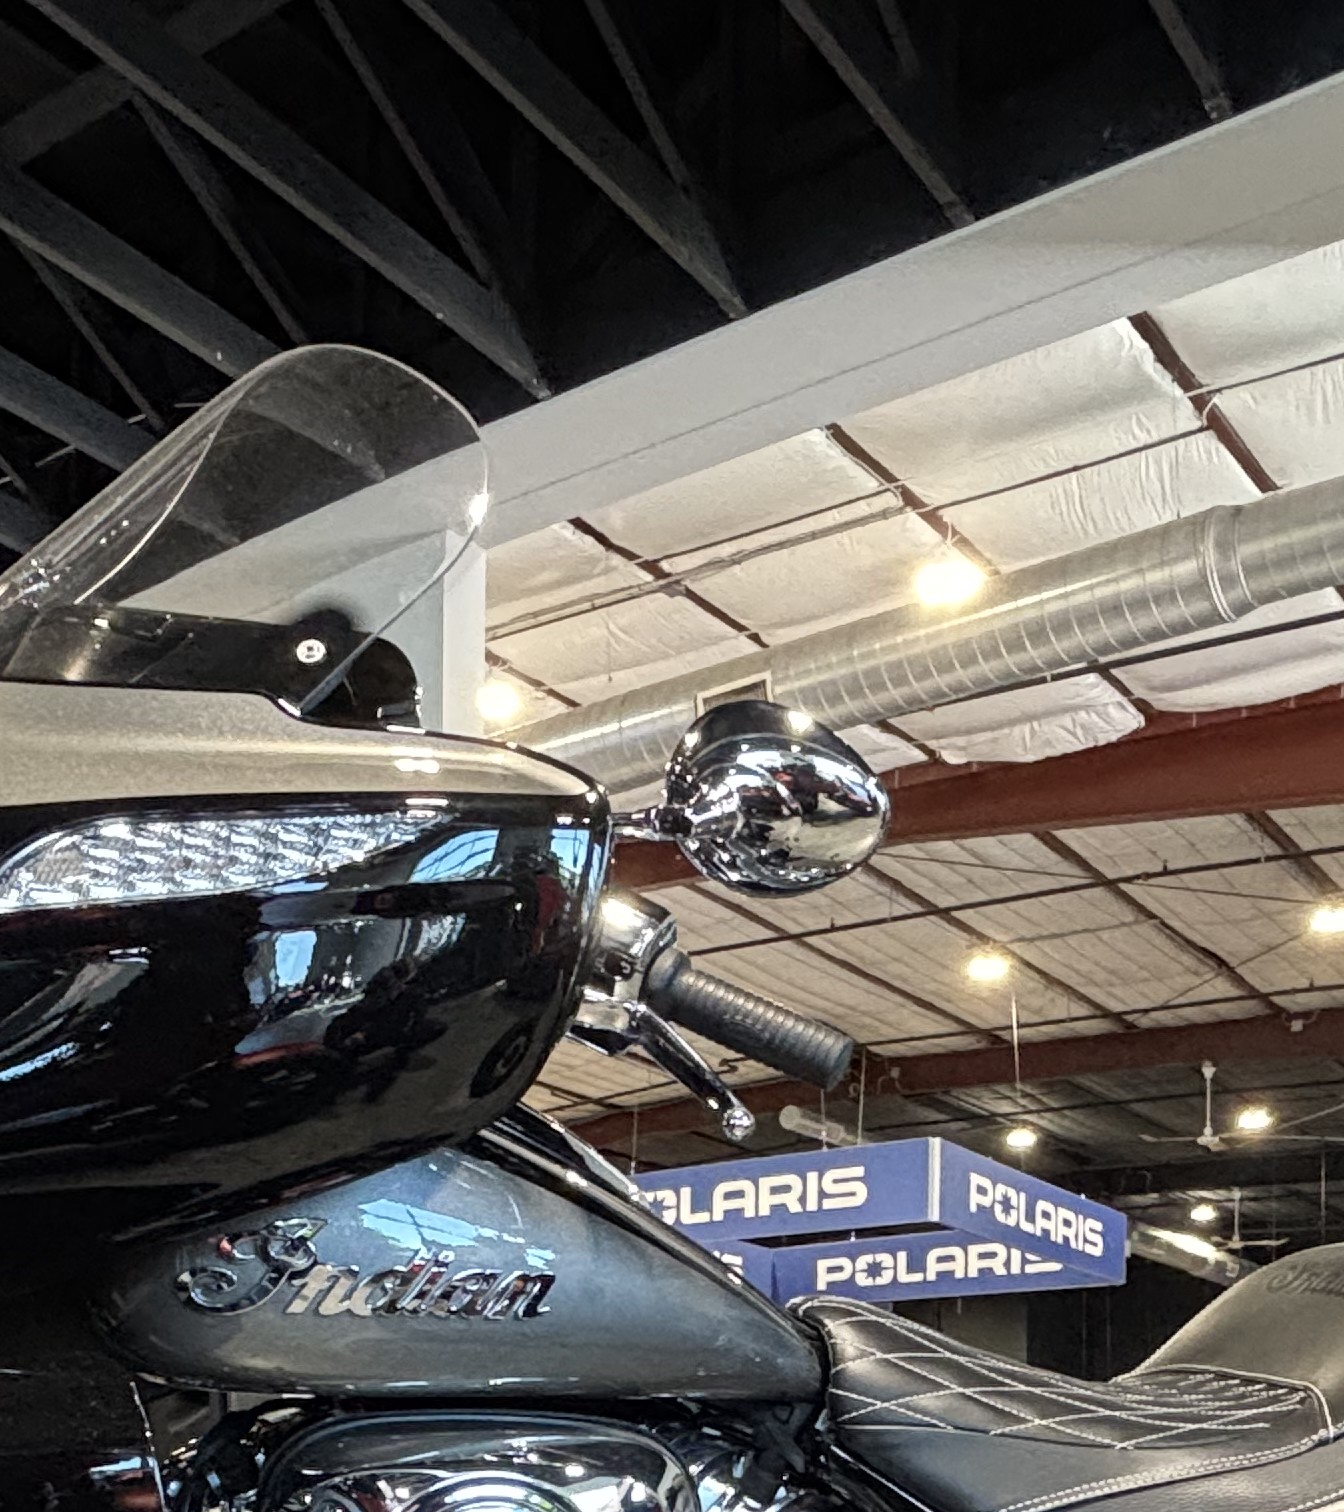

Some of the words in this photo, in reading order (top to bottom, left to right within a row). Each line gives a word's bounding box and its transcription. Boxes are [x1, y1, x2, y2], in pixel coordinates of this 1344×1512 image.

[645, 1165, 868, 1226] OLARIS
[969, 1172, 1104, 1257] POLARIS
[175, 1217, 556, 1320] Indian
